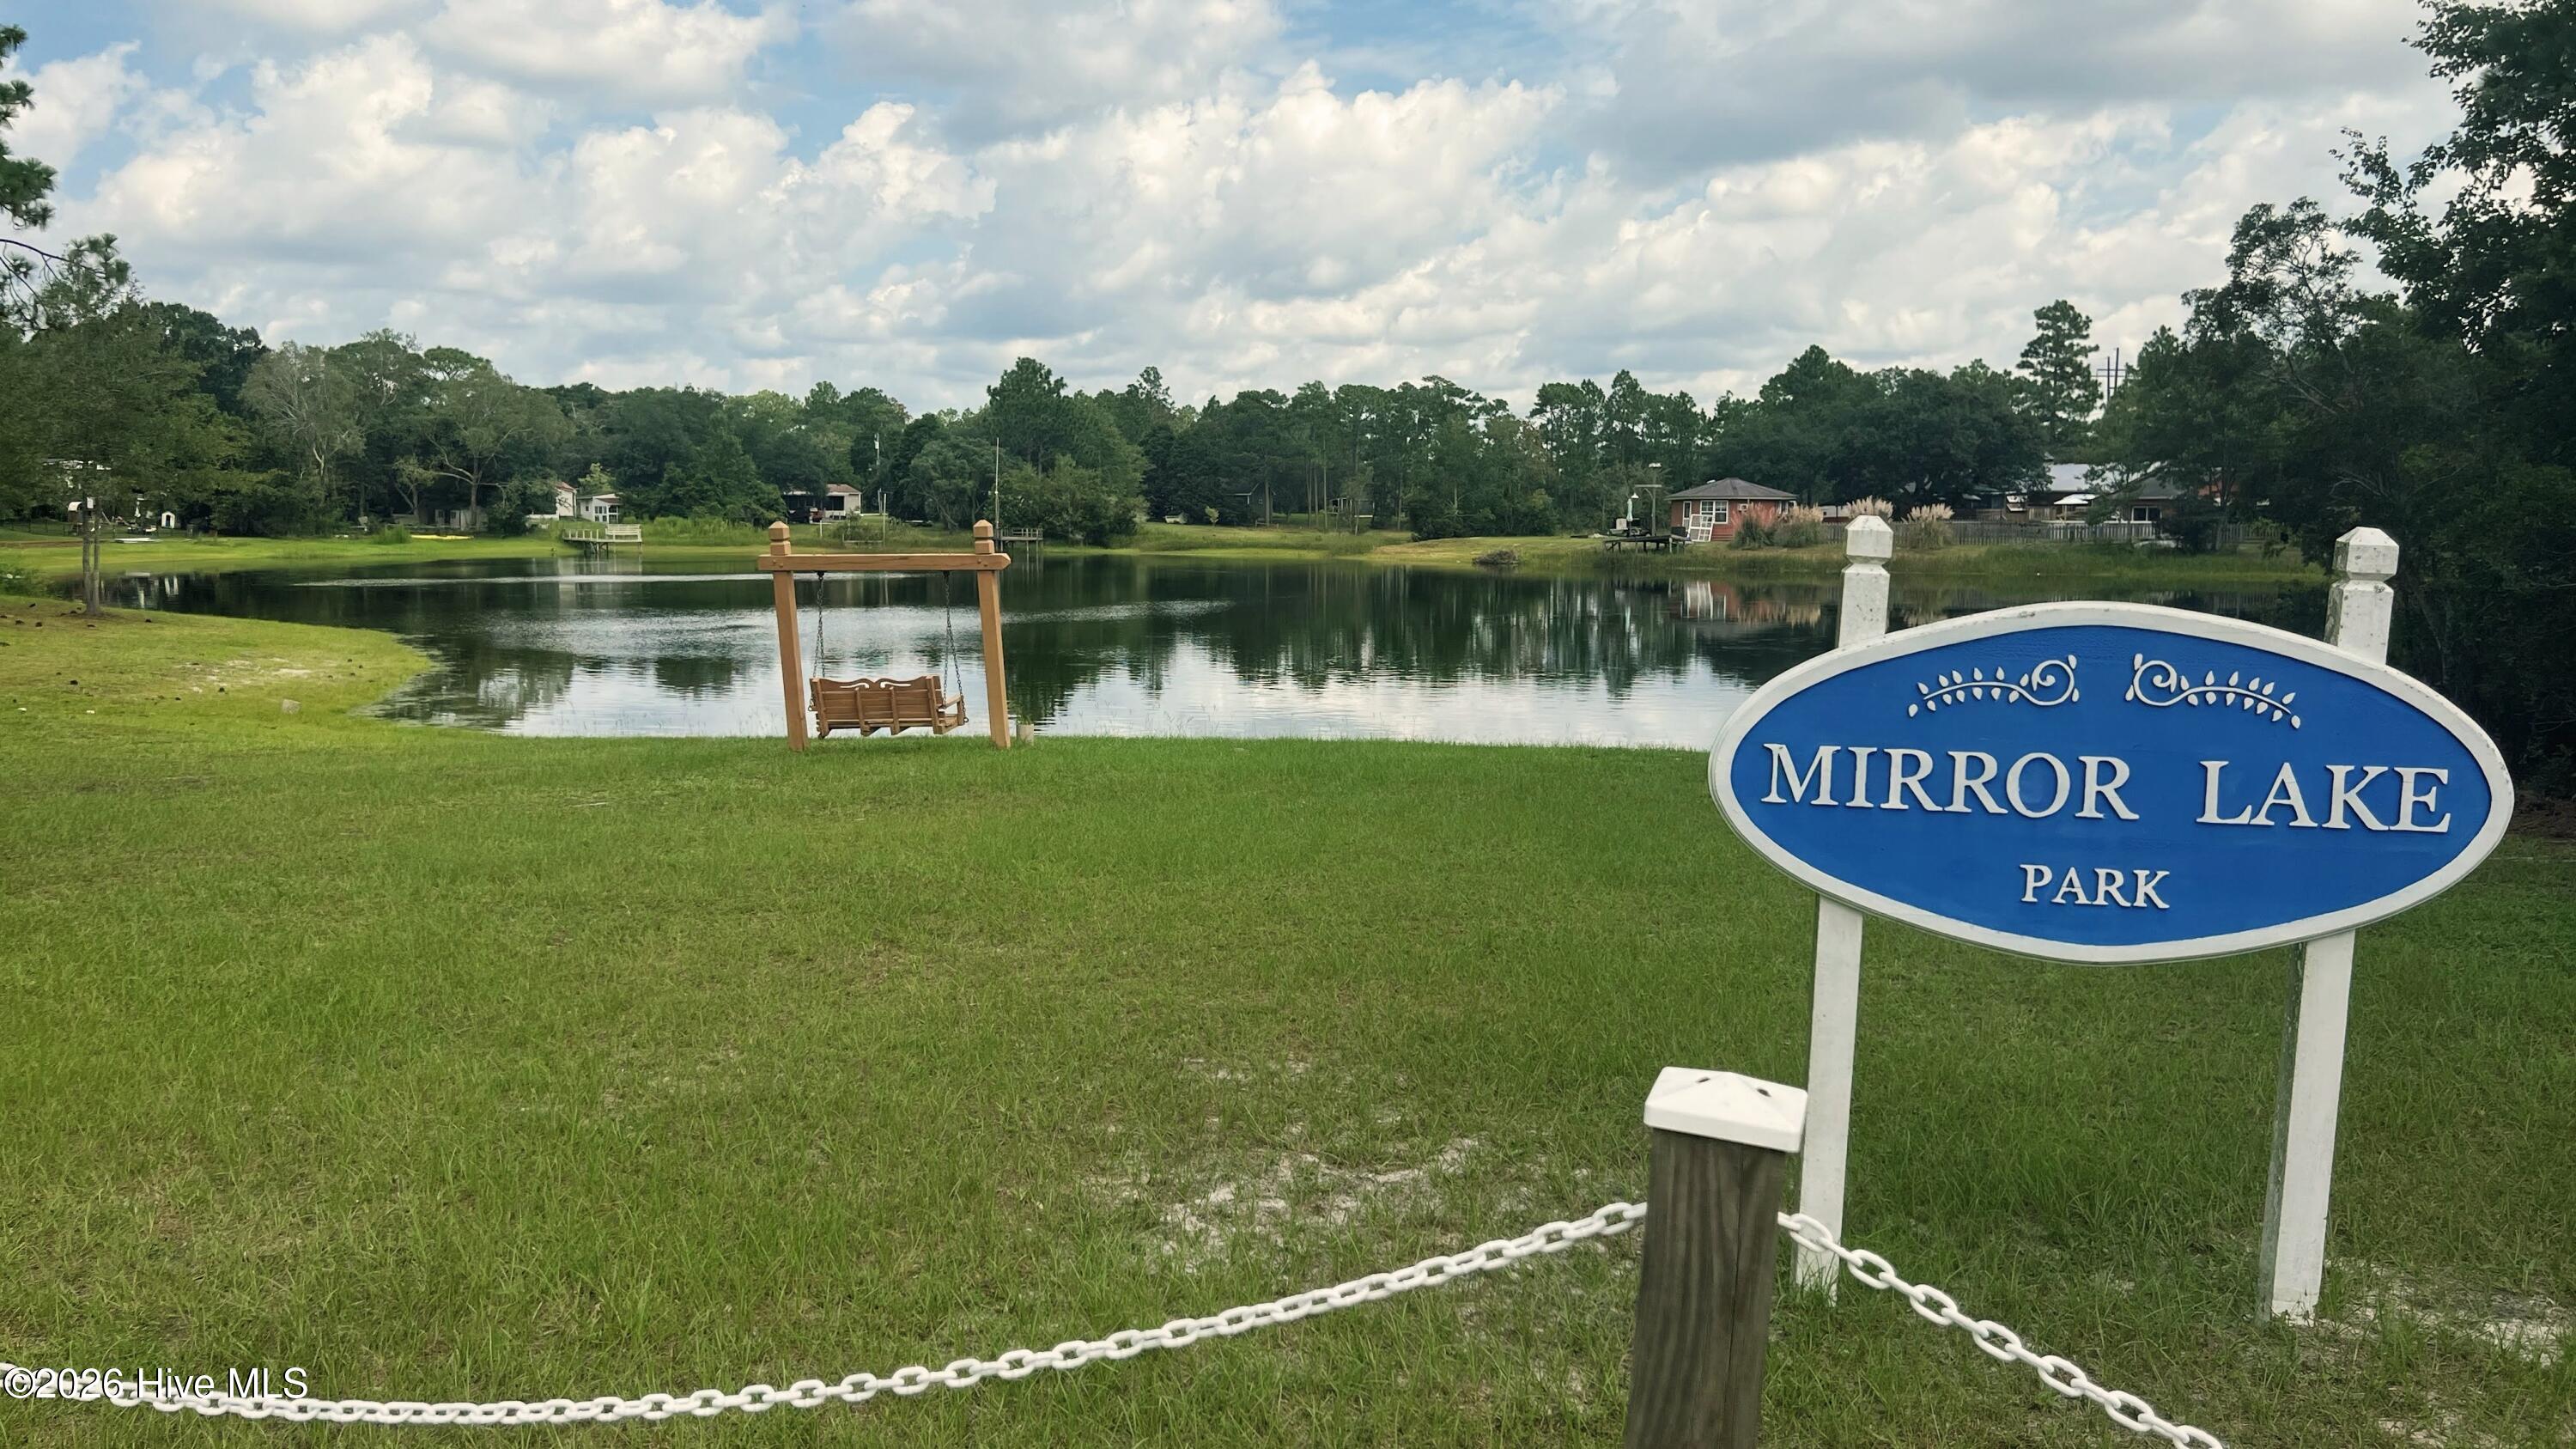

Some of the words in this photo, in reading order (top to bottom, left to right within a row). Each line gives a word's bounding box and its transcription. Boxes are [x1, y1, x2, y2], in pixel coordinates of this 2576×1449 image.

[1761, 743, 2140, 820] MIRROR
[2196, 760, 2451, 834] LAKE
[2020, 864, 2170, 910] PARK
